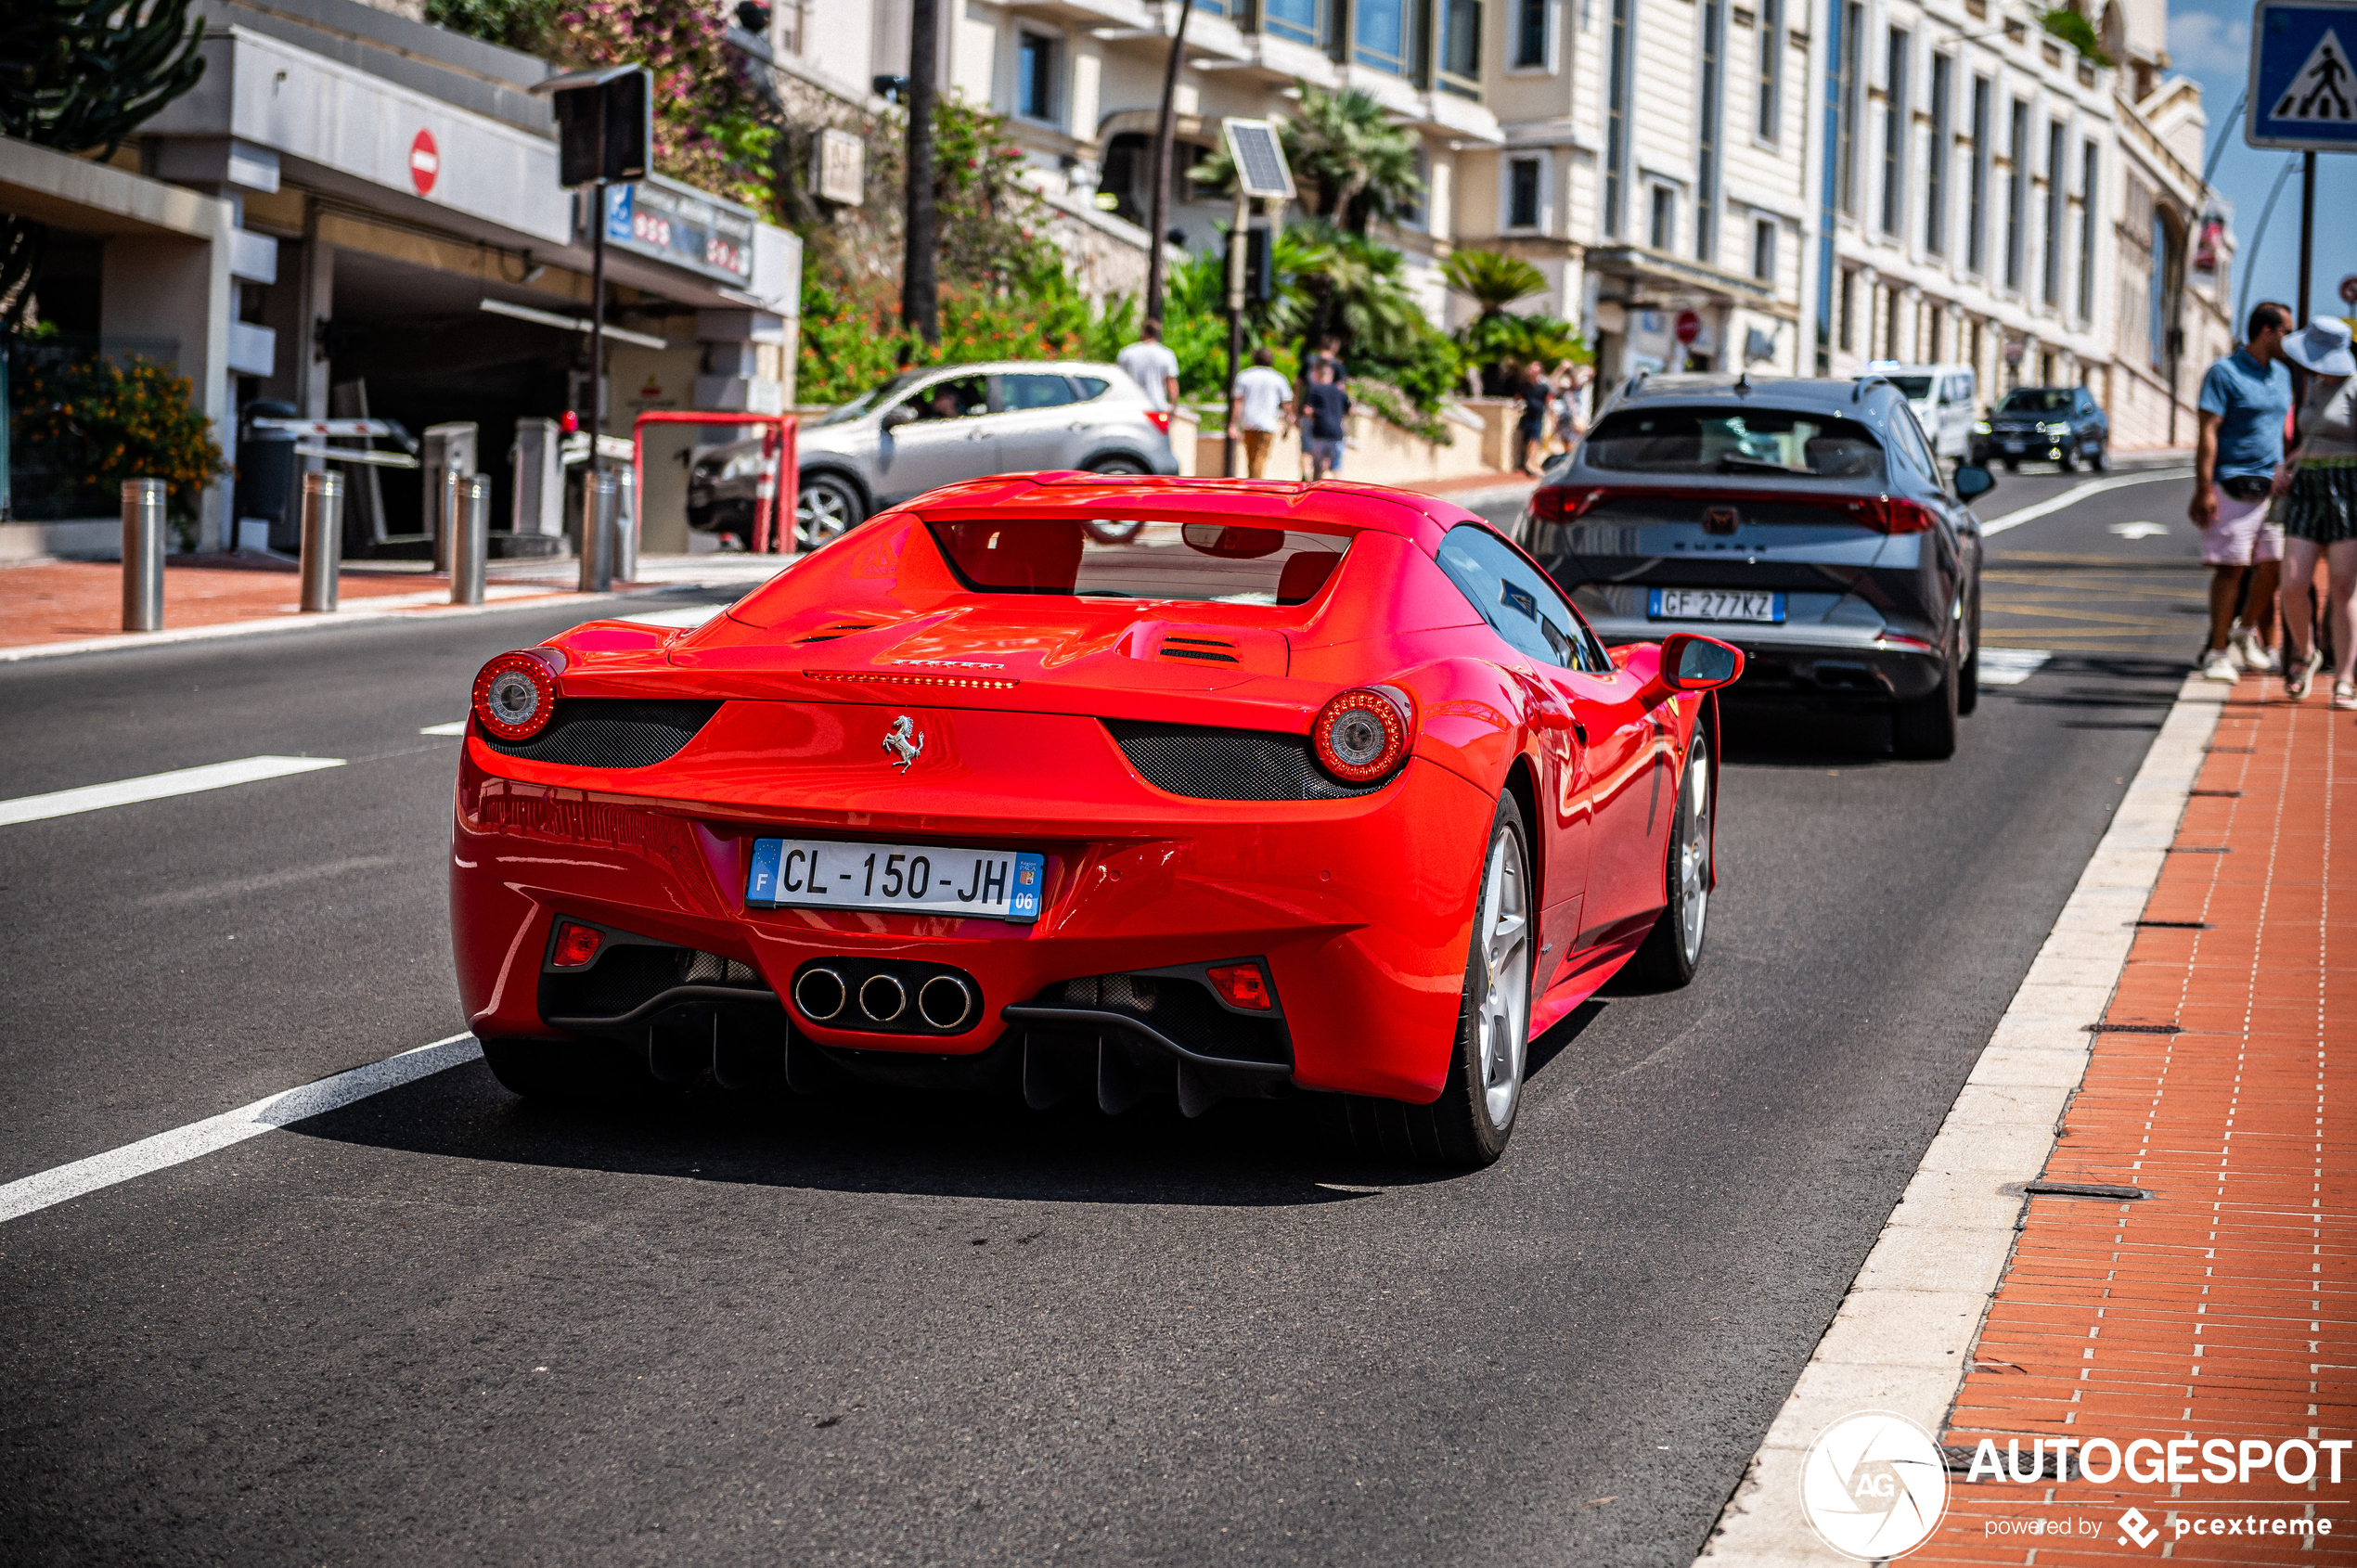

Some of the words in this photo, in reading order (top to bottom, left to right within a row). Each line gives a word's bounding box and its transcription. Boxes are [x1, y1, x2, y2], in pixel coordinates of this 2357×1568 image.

[1665, 592, 1691, 615] GF
[1700, 593, 1769, 617] 277KZ
[756, 873, 768, 892] F
[1015, 892, 1034, 910] 06
